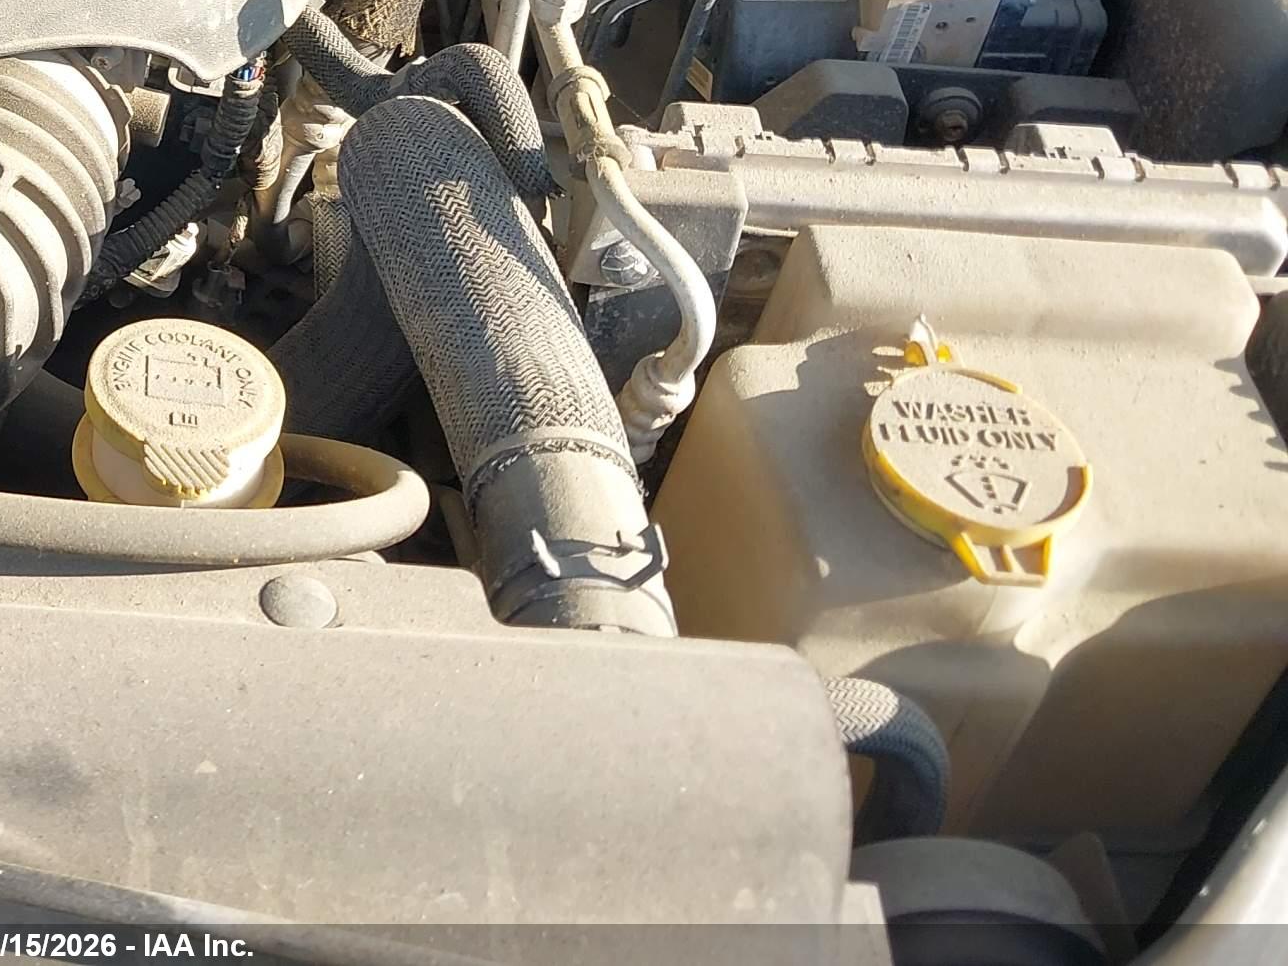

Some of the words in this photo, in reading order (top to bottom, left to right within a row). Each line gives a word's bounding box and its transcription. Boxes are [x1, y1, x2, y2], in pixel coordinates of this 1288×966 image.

[113, 339, 143, 391] ENGINE
[144, 331, 243, 364] COOLANT
[234, 365, 258, 409] ONLY
[891, 398, 1034, 428] WASHER
[877, 421, 972, 447] FLUID
[975, 427, 1058, 453] ONLY
